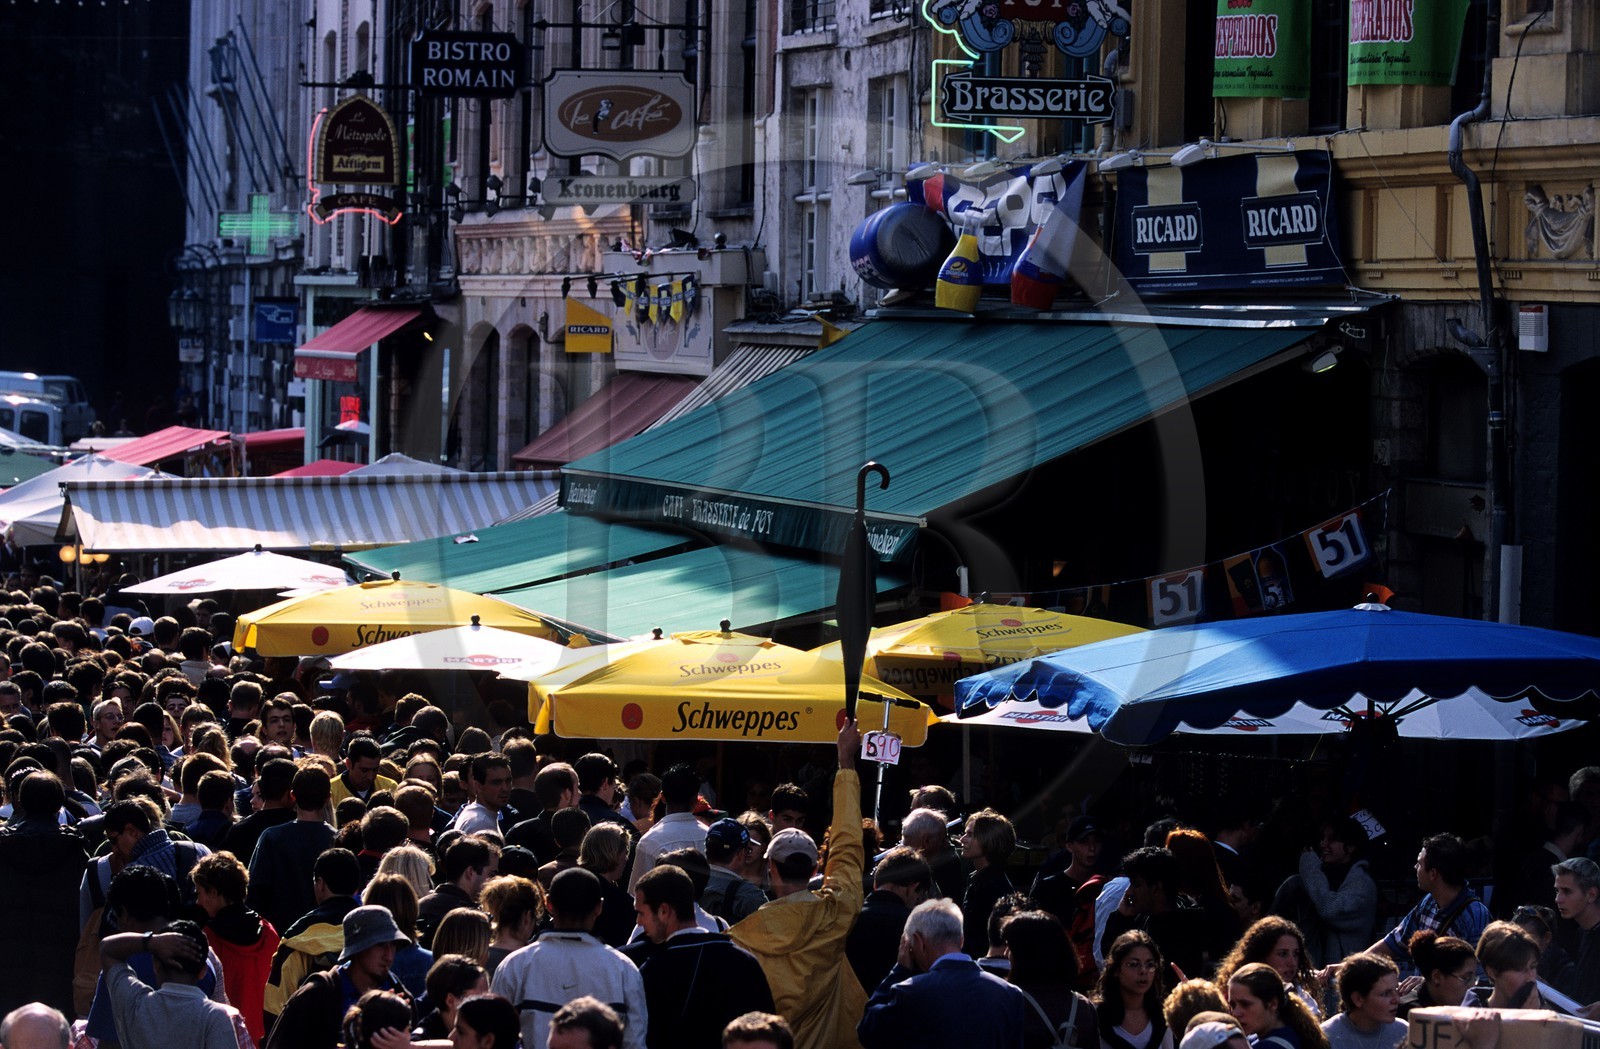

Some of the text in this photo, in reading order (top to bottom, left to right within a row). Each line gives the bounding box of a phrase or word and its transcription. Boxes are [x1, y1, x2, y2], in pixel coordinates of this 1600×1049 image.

[428, 41, 511, 62] BISTRO
[424, 68, 515, 88] ROMAIN
[951, 80, 1105, 113] Brasserie
[558, 179, 681, 201] Kronenbourg
[1136, 214, 1199, 244] RICARD
[1247, 204, 1318, 238] RICARD
[569, 326, 609, 334] RICARD
[1317, 519, 1362, 566] 51
[1159, 575, 1199, 616] 51
[352, 625, 424, 647] Schwe
[976, 622, 1063, 639] Schweppes
[680, 661, 781, 678] Schweppes
[672, 701, 800, 736] Schweppes
[1003, 711, 1068, 722] MARTINI
